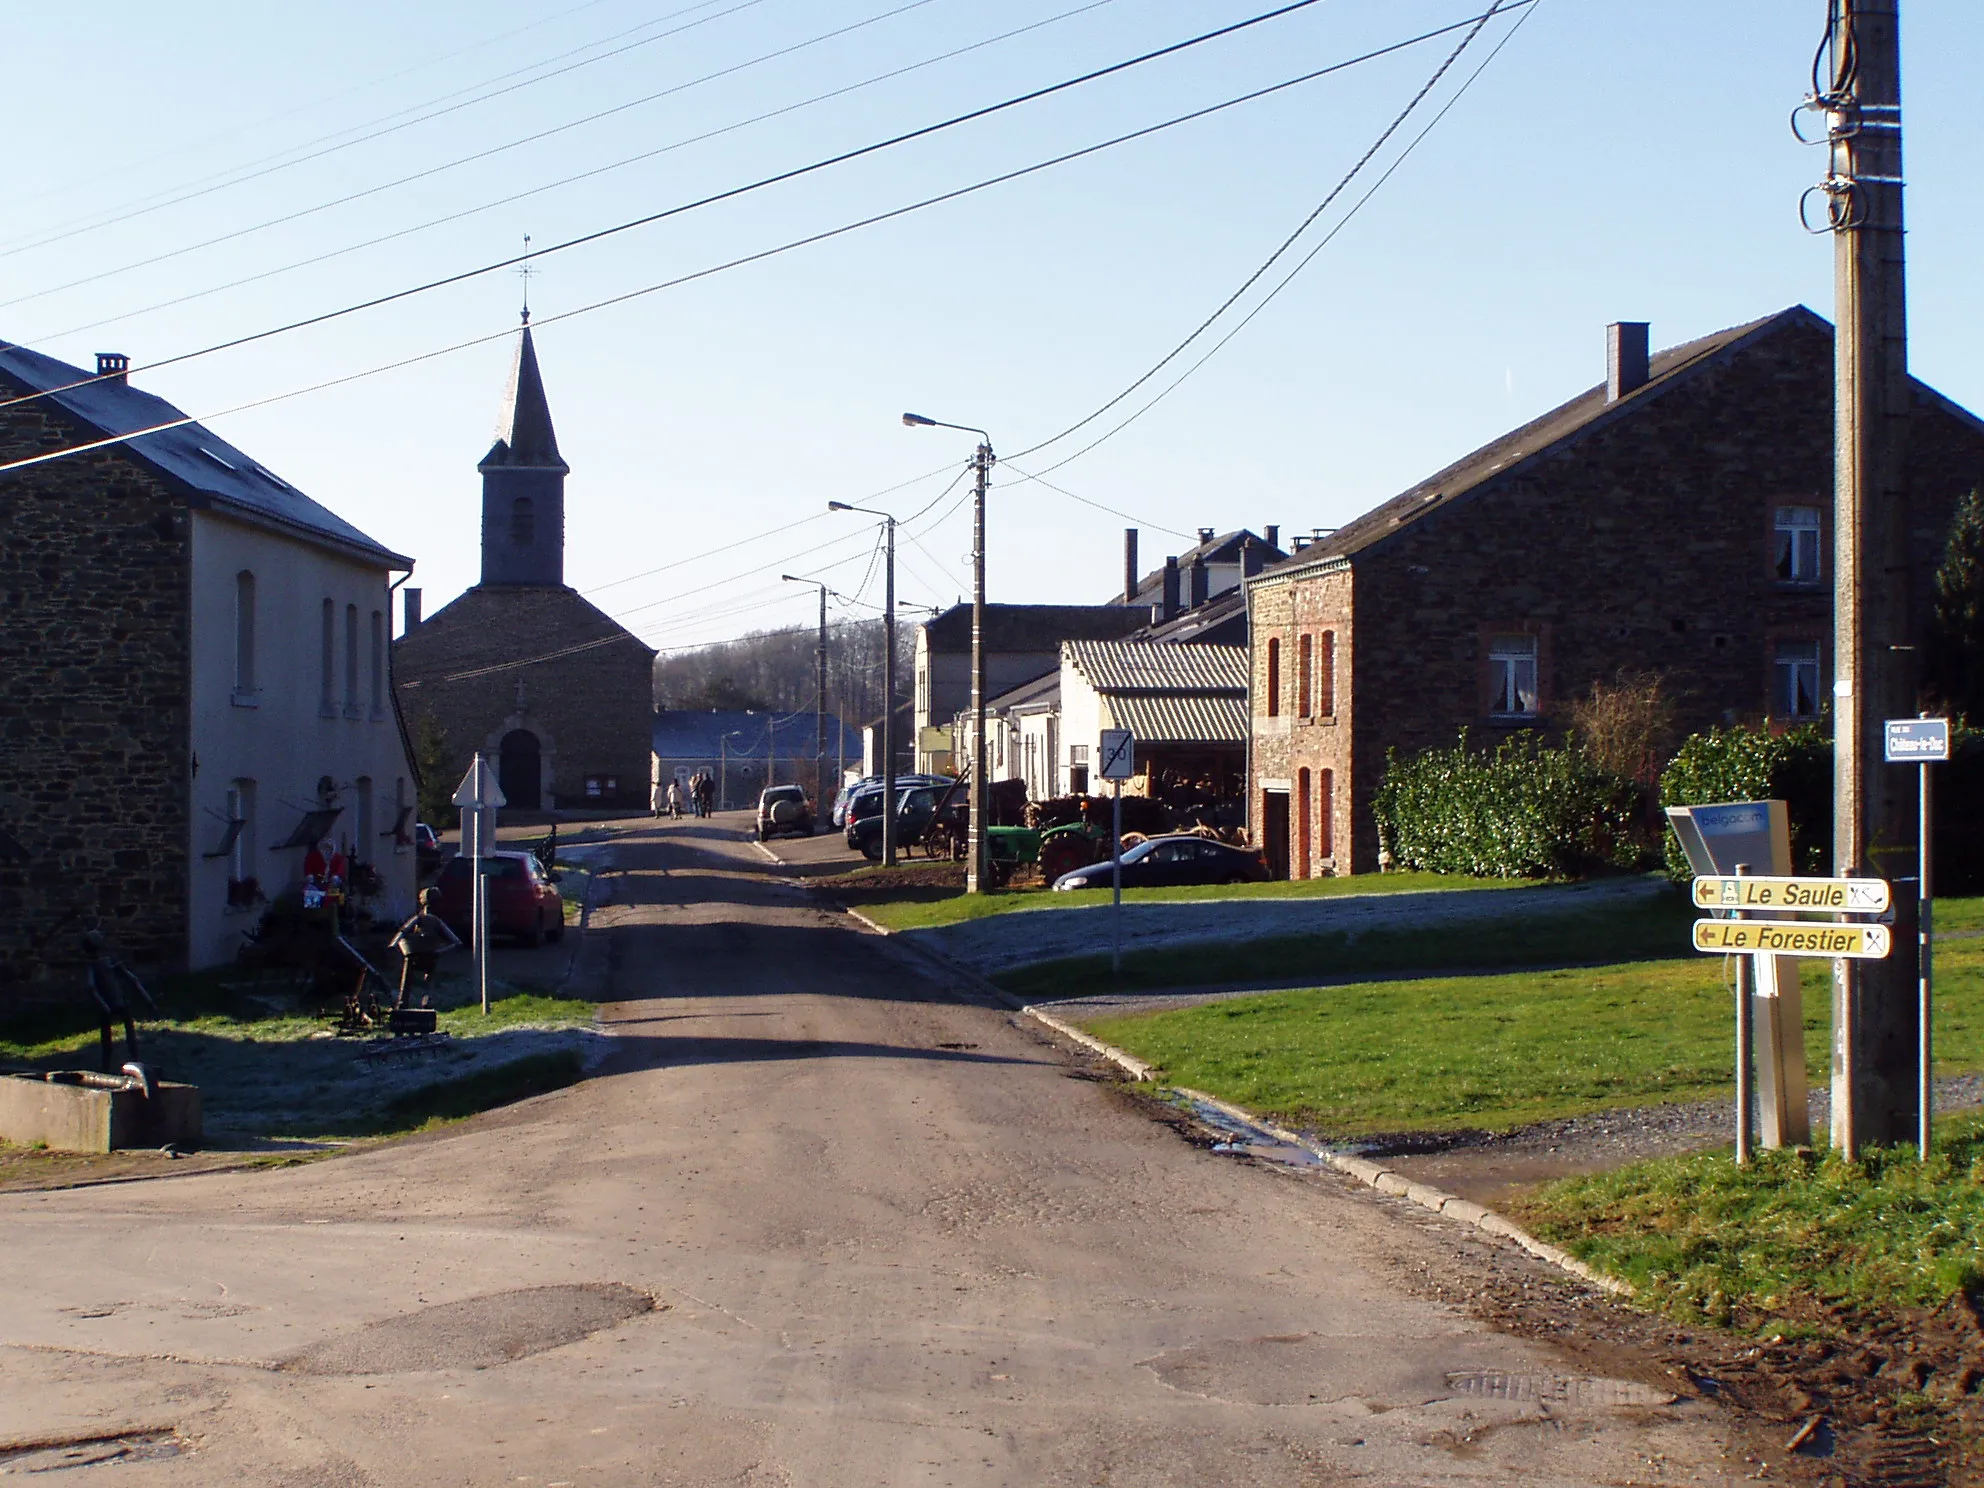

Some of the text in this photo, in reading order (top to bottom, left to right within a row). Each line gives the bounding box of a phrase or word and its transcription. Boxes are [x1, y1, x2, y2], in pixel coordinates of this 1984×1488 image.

[1107, 747, 1126, 761] 30
[1746, 883, 1843, 906] Le Saule
[1721, 926, 1857, 951] Le Forestier
